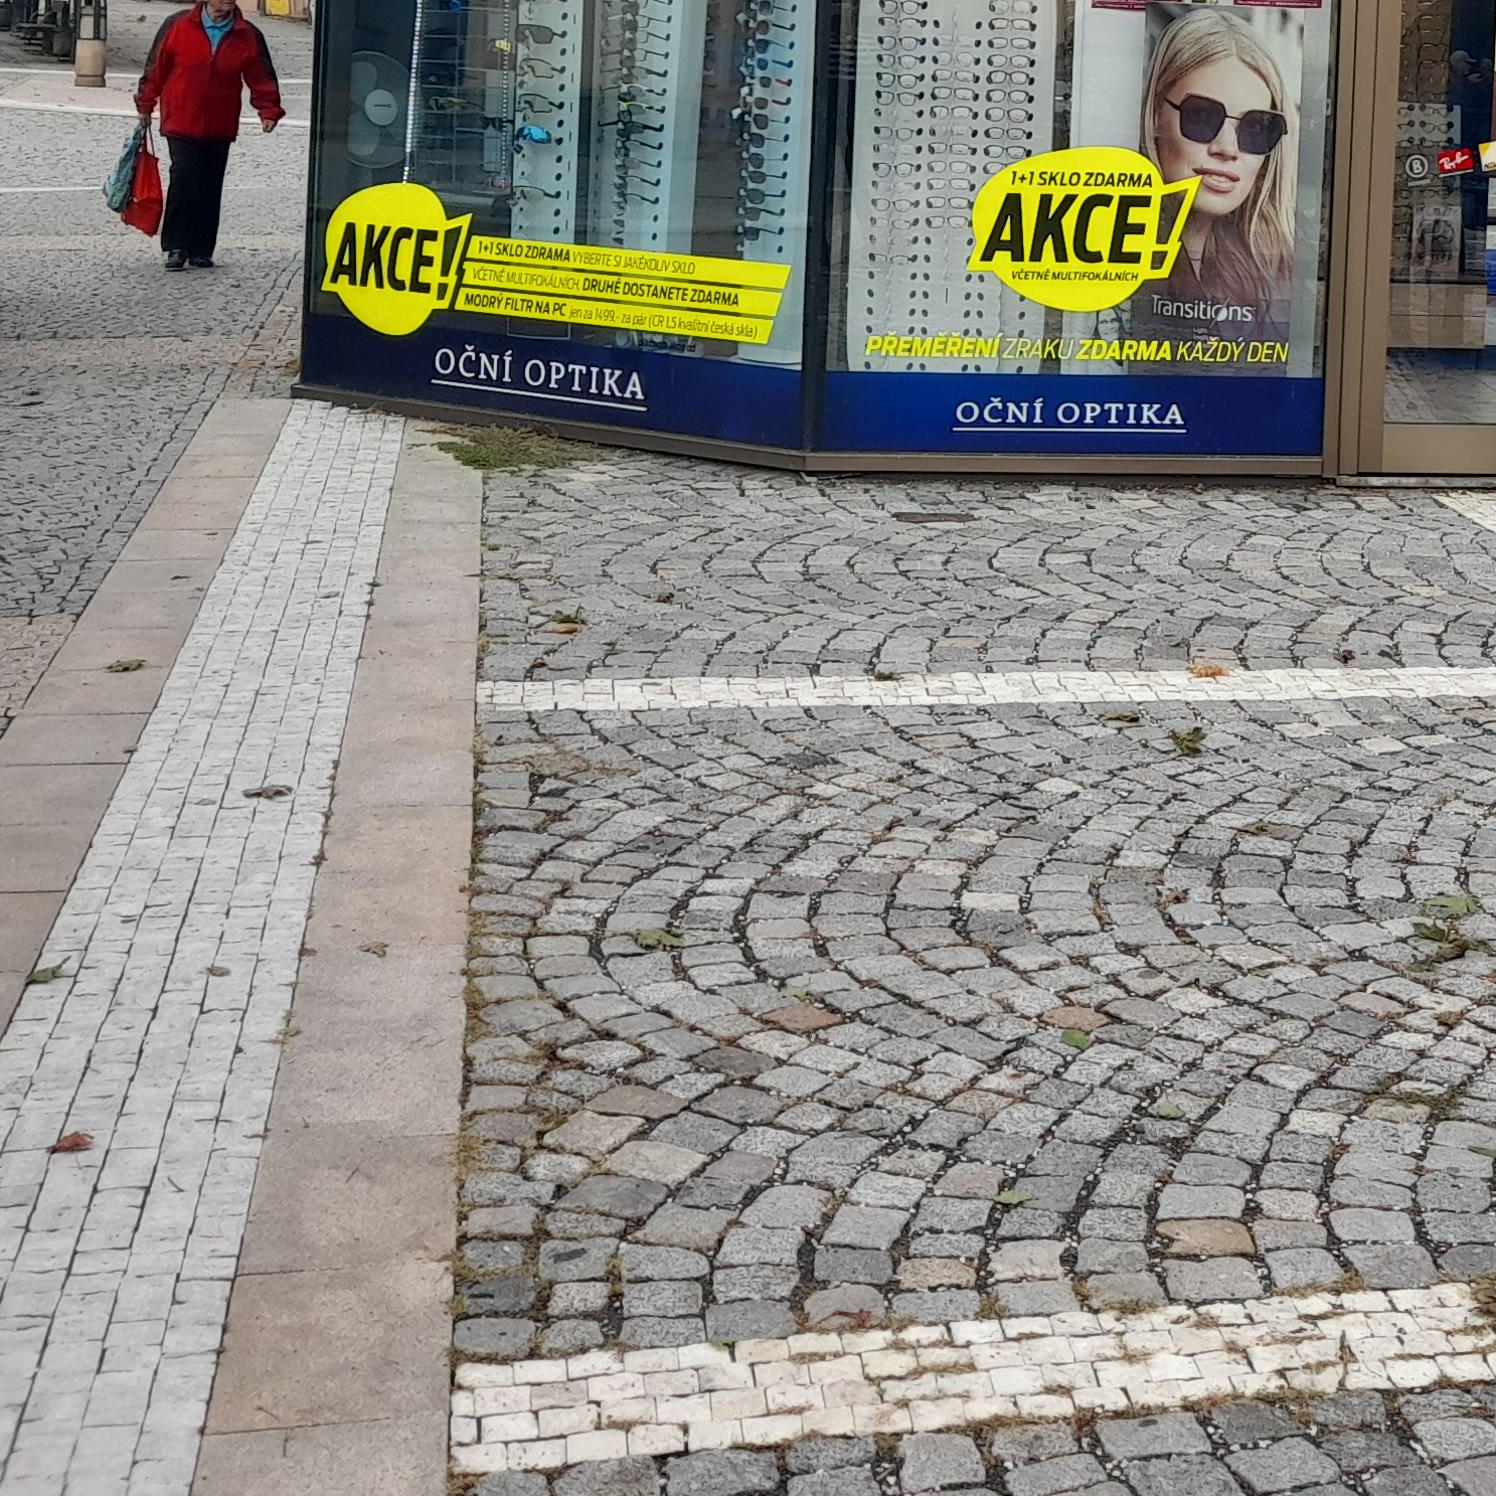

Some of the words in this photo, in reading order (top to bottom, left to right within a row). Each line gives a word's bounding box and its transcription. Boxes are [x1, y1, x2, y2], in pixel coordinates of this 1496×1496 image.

[1010, 170, 1035, 187] 1+1
[1037, 171, 1080, 187] SKLO
[1082, 171, 1153, 188] ZDARMA
[979, 190, 1188, 271] AKCE!
[329, 221, 464, 302] AKCE!
[478, 241, 494, 255] 1+1
[496, 242, 523, 258] SKLO
[525, 245, 570, 262] ZDRAMA
[671, 261, 695, 275] SKLO
[582, 277, 621, 295] DRUHÉ
[623, 282, 688, 301] DOSTANETE
[690, 289, 739, 307] ZDARMA
[1011, 269, 1050, 282] VČETNĚ
[1051, 269, 1139, 283] MULTIFOKÁLNÍCH
[464, 293, 503, 308] MODRÝ
[504, 297, 533, 313] FILTR
[535, 301, 550, 315] NA
[552, 303, 567, 316] PC
[568, 306, 582, 319] jen
[583, 309, 593, 319] za
[621, 314, 630, 323] za
[632, 312, 647, 327] pár
[1151, 295, 1254, 323] Transitions
[865, 331, 1004, 359] PŘEMĚŘENÍ
[1002, 338, 1076, 360] ZRAKU
[1076, 338, 1171, 362] ZDARMA
[1175, 336, 1245, 362] KAŽDÝ
[1246, 341, 1289, 363] DEN
[434, 343, 513, 384] OČNÍ
[525, 360, 646, 401] OPTIKA
[956, 396, 1044, 426] OČNÍ
[1057, 401, 1185, 426] OPTIKA
